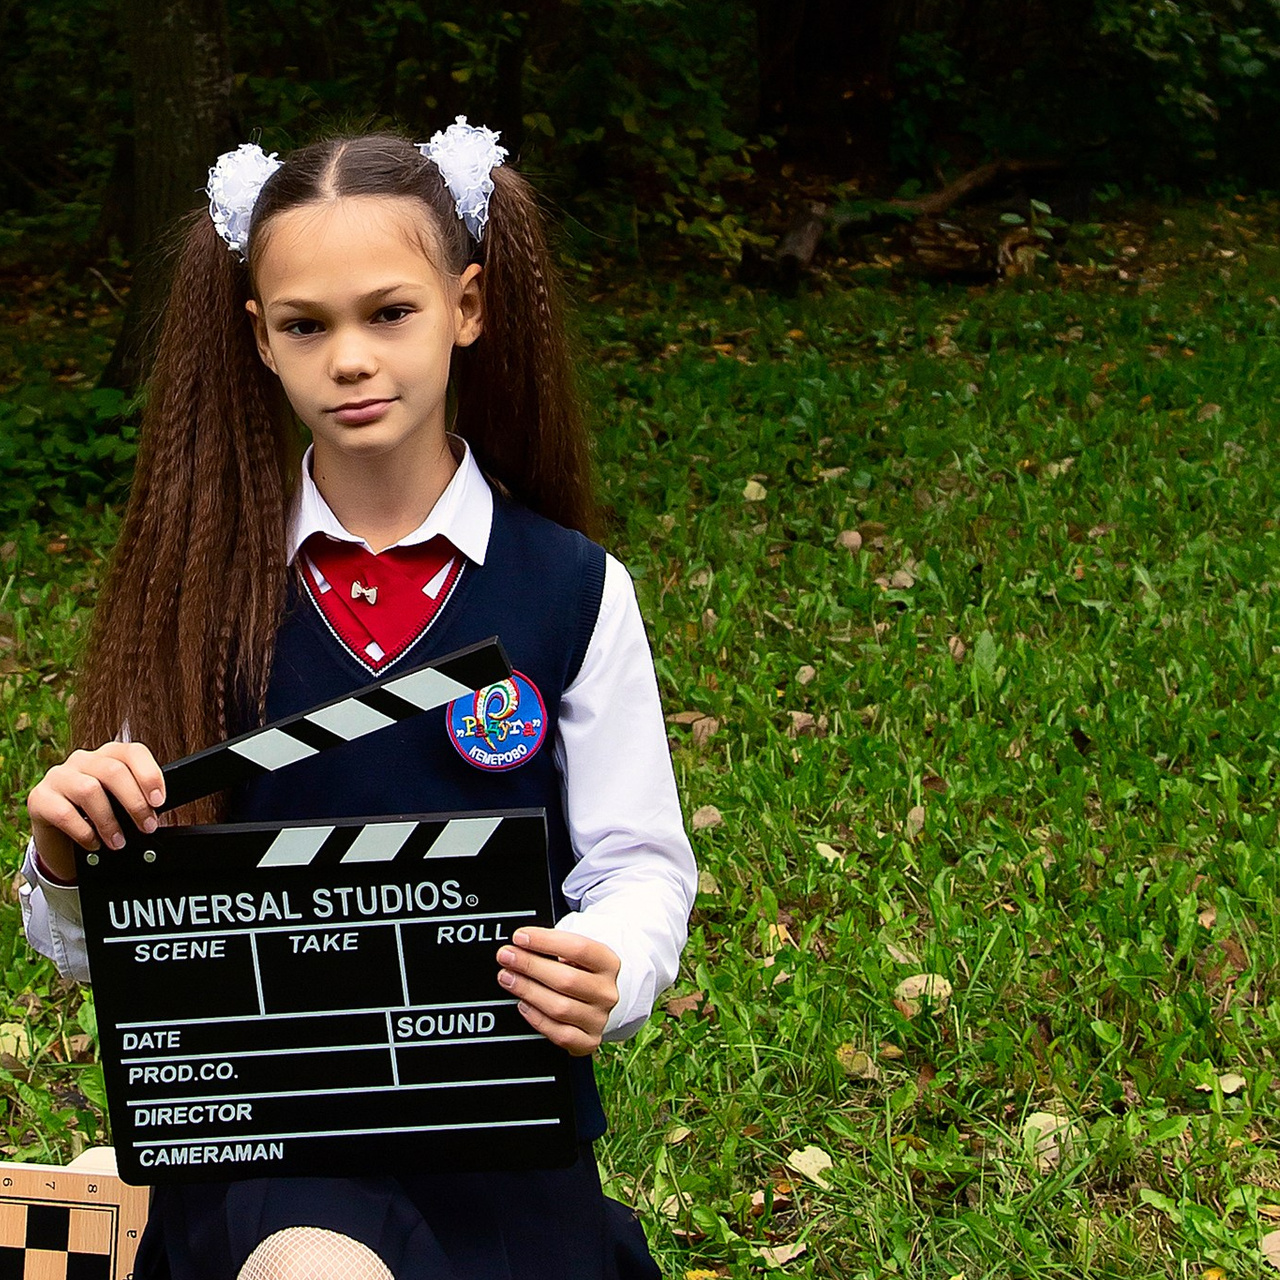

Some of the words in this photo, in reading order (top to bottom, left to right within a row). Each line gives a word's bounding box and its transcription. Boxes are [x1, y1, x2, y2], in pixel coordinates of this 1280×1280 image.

[109, 890, 303, 929] UNIVERSAL
[288, 932, 359, 954] TAKE
[436, 923, 509, 945] ROLL
[134, 939, 227, 963] SCENE
[396, 1011, 496, 1038] SOUND
[122, 1030, 181, 1051] DATE
[128, 1062, 239, 1085] PROD.CO.
[134, 1103, 253, 1127] DIRECTOR
[139, 1142, 284, 1167] CAMERAMAN
[2, 1177, 13, 1187] 6
[45, 1181, 56, 1190] 7
[87, 1184, 98, 1194] 8
[126, 1229, 137, 1239] a
